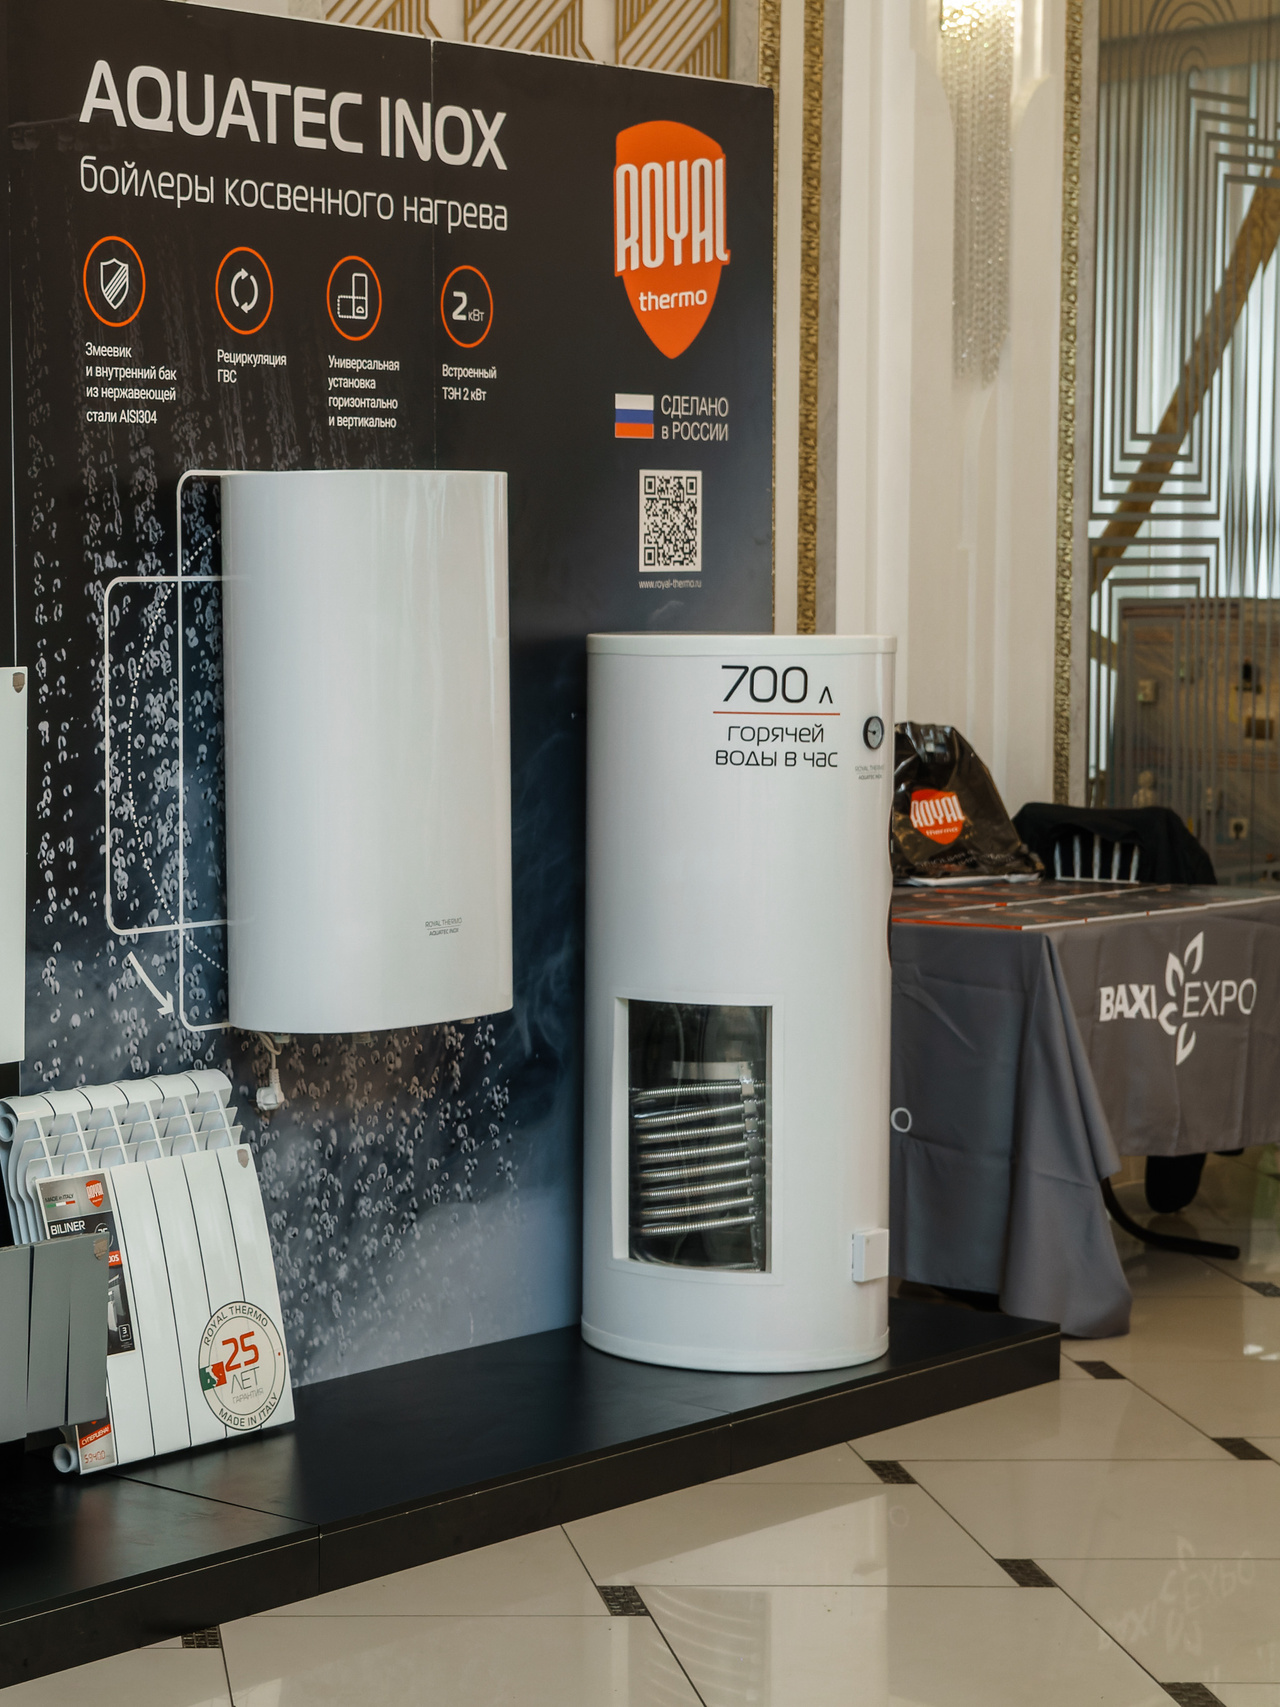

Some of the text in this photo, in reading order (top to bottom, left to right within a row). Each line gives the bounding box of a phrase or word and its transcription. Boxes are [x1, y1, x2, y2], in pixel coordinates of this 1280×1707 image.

[80, 60, 507, 170] AQUATEC INOX
[80, 156, 508, 234] бойлеры косвенного нагрева
[616, 158, 728, 272] ROYAL
[452, 291, 484, 322] 2 кВт
[639, 289, 707, 311] thermo
[85, 342, 132, 358] Змеевик
[217, 349, 287, 366] Рециркуляция
[328, 355, 400, 371] Универсальная
[442, 364, 497, 380] Встроенный
[86, 365, 177, 382] и внутренний бак
[217, 370, 237, 383] ГВС
[328, 375, 376, 391] установка
[86, 385, 176, 402] из нержавеющей
[328, 396, 398, 410] горизонтально
[442, 387, 487, 401] ТЭН 2 кВт
[86, 409, 157, 424] стали AISI304
[661, 395, 729, 419] СДЕЛАНО
[328, 415, 397, 429] и вертикально
[662, 422, 729, 441] в РОССИИ
[722, 665, 808, 703] 700
[728, 724, 824, 746] горячей
[716, 750, 838, 767] воды в час
[911, 795, 965, 828] ROYAL
[1099, 978, 1256, 1022] BAXI EXPO
[50, 1220, 85, 1235] BILINER
[204, 1305, 268, 1346] ROYAL THERMO
[222, 1331, 259, 1372] 25
[231, 1366, 260, 1394] ЛЕТ
[219, 1392, 277, 1426] MADE IN ITALY
